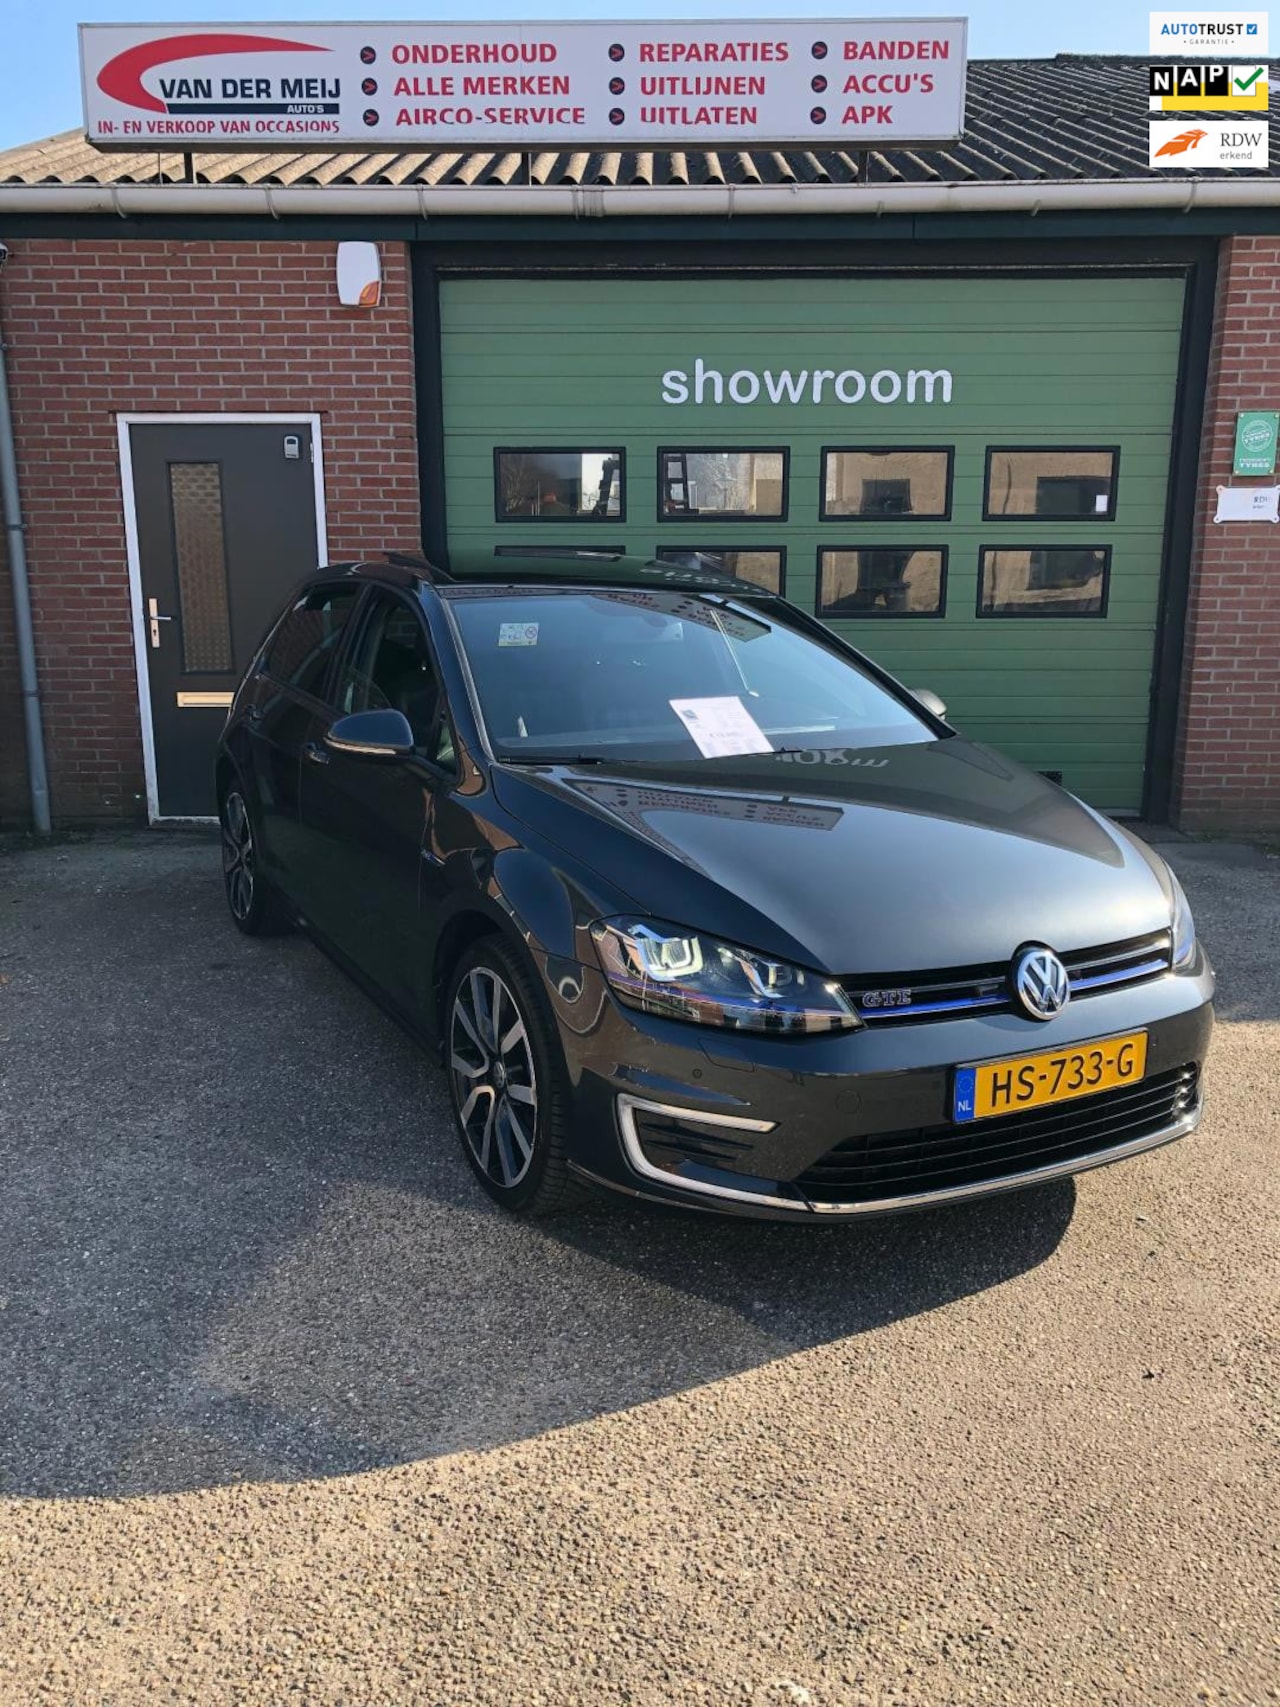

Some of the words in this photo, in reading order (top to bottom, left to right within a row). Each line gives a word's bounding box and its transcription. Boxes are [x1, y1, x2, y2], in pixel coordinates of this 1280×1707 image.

[391, 43, 558, 65] ONDERHOUD
[638, 41, 790, 63] REPARATIES
[842, 39, 950, 61] BANDEN
[159, 78, 213, 99] VAN
[221, 78, 272, 99] DER
[280, 77, 341, 99] MEIJ
[393, 76, 455, 97] ALLE
[463, 75, 570, 96] MERKEN
[640, 75, 766, 96] UITLIJNEN
[842, 73, 935, 94] ACCU'S
[287, 104, 325, 114] AUTO'S
[395, 106, 586, 126] AIRCO-SERVICE
[640, 105, 758, 126] UITLATEN
[841, 104, 894, 125] APK
[98, 120, 119, 134] IN-
[123, 120, 142, 134] EN
[146, 120, 216, 134] VERKOOP
[220, 120, 251, 134] VAN
[255, 120, 340, 134] OCCASIONS
[661, 358, 953, 404] showroom
[862, 988, 912, 1008] GTE
[991, 1043, 1134, 1108] HS-733-G
[957, 1100, 972, 1112] NL
